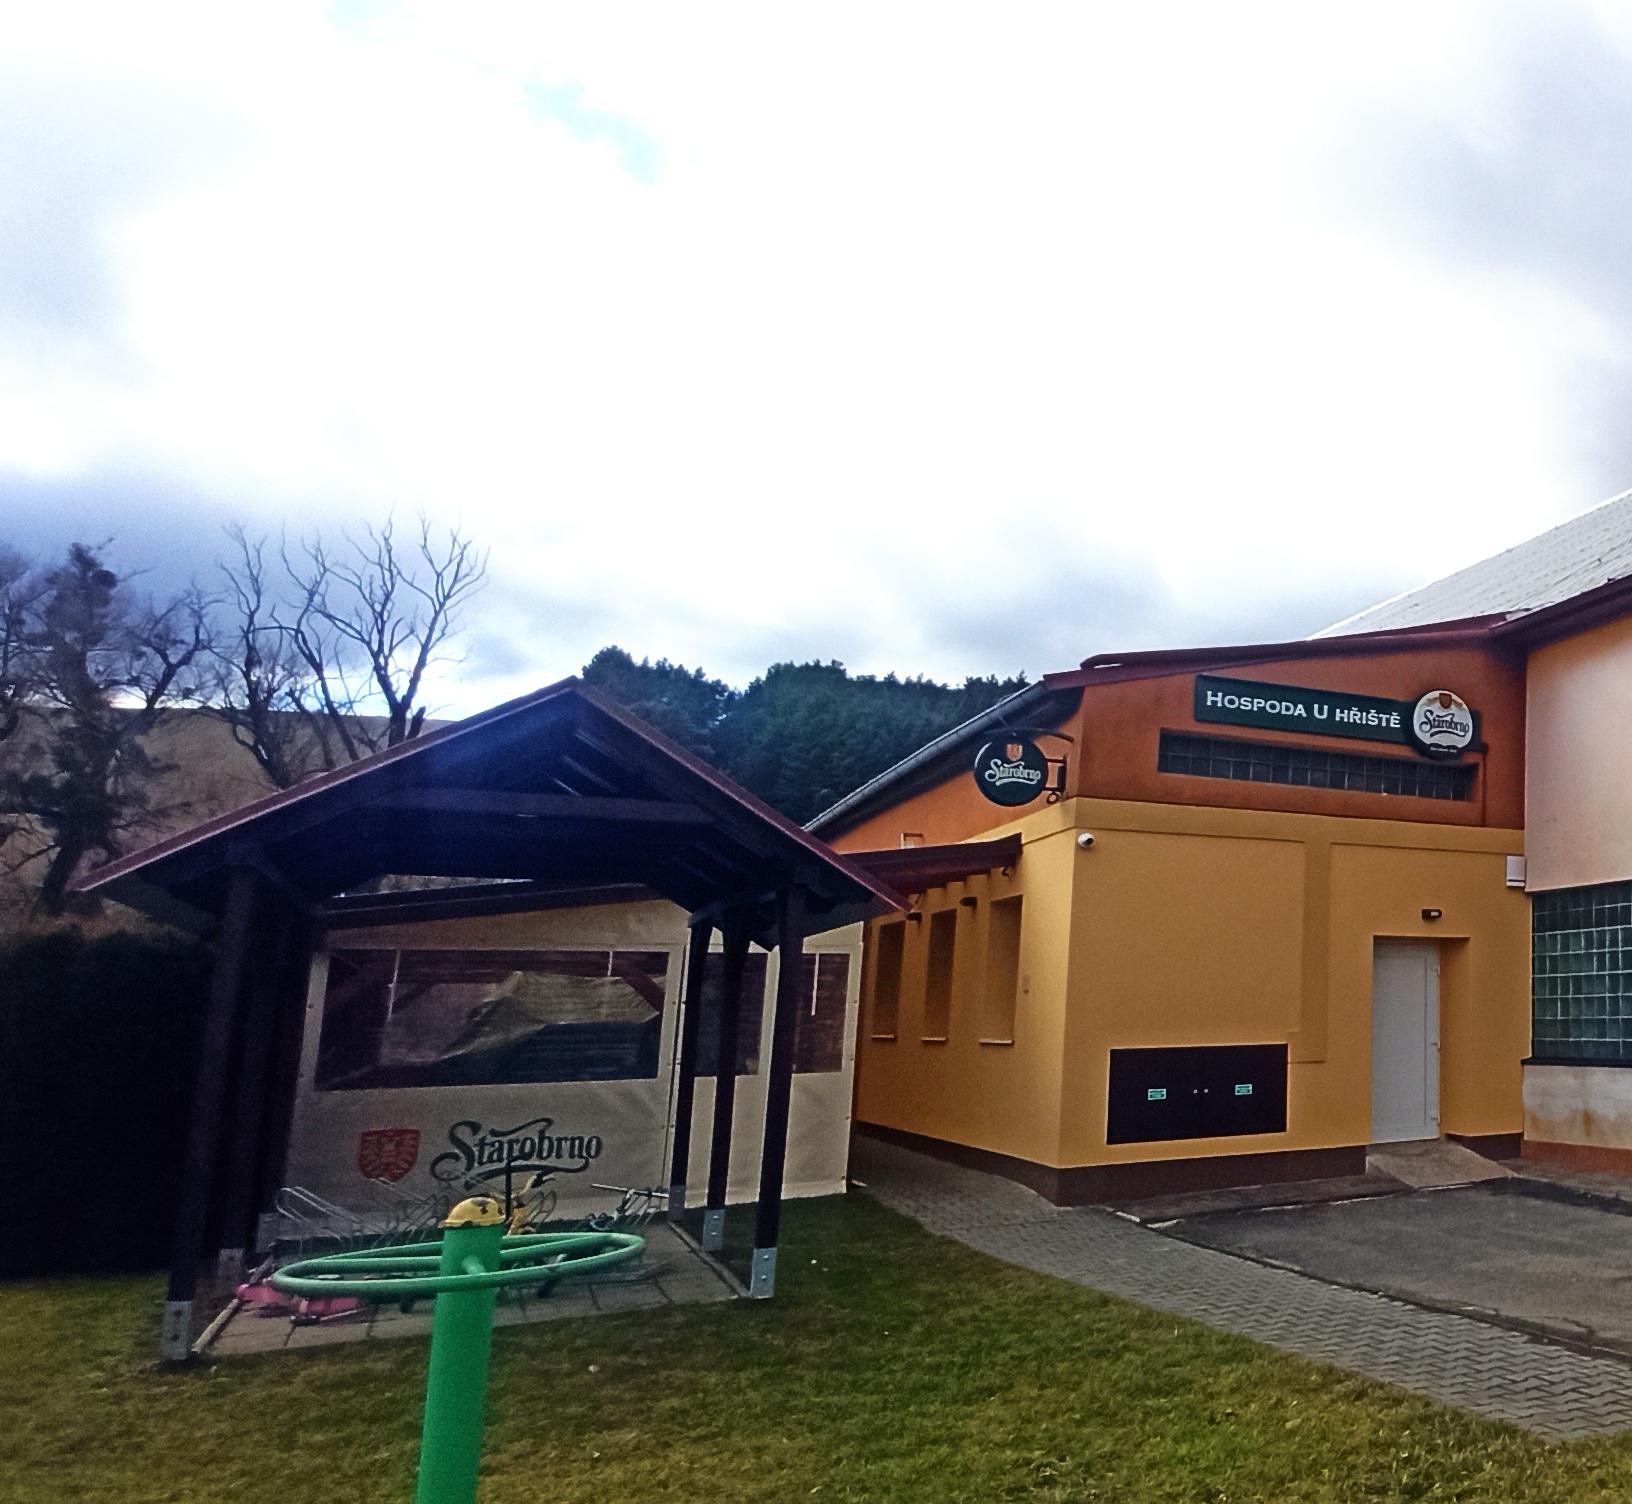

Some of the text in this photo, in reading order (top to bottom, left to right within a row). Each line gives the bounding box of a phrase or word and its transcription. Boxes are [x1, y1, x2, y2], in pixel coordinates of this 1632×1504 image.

[1206, 691, 1307, 718] HOSPODA
[1313, 703, 1329, 720] U
[1419, 709, 1470, 738] Starobrno
[985, 758, 1042, 786] Starobrno
[430, 1117, 603, 1190] Starobrno
